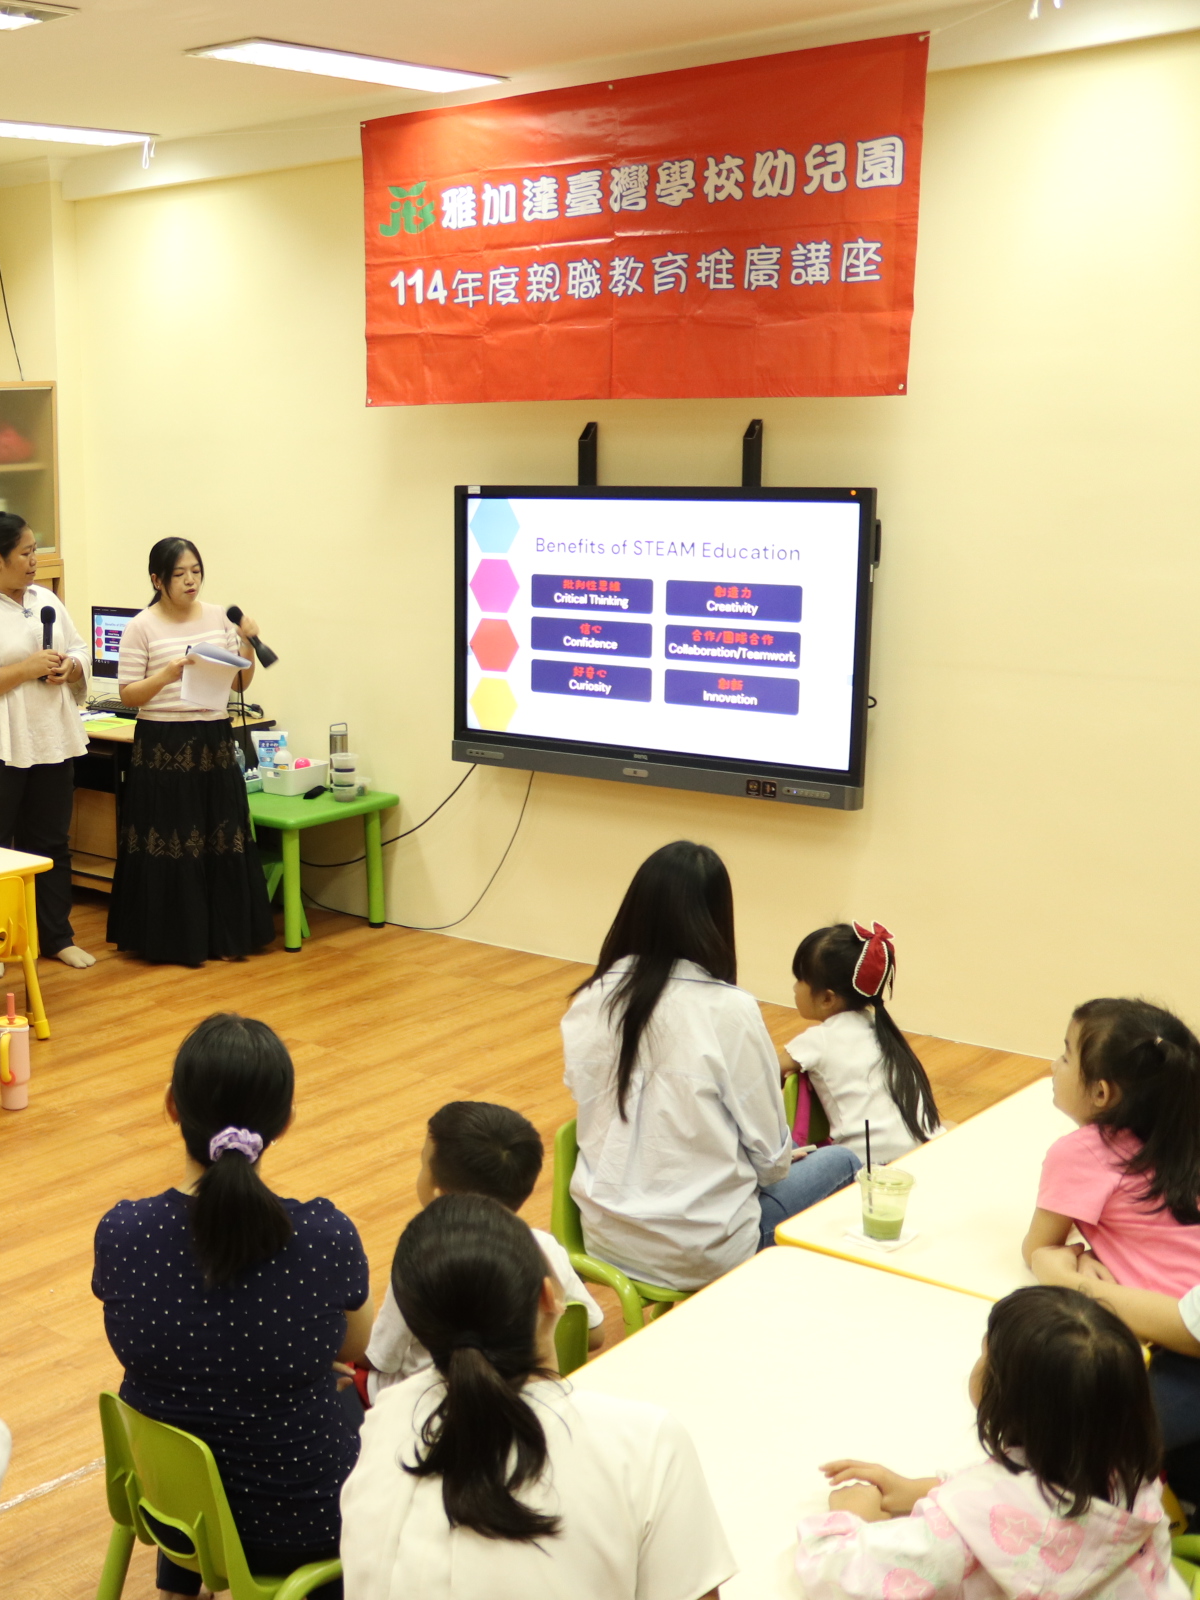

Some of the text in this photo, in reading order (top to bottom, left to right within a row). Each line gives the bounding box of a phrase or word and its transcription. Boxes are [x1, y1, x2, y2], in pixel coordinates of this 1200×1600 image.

[440, 135, 904, 230] 雅加達臺灣學校幼兒園
[390, 237, 883, 308] 114年度親職教育推廣講座
[536, 537, 801, 561] Benefits of STEAM Education
[553, 592, 630, 610] Critical Thinking
[705, 600, 759, 617] Creativity
[562, 635, 619, 650] Confidence
[668, 643, 797, 663] Collaboration/Teamwork
[568, 679, 612, 696] Curiosity
[703, 690, 758, 706] Innovation
